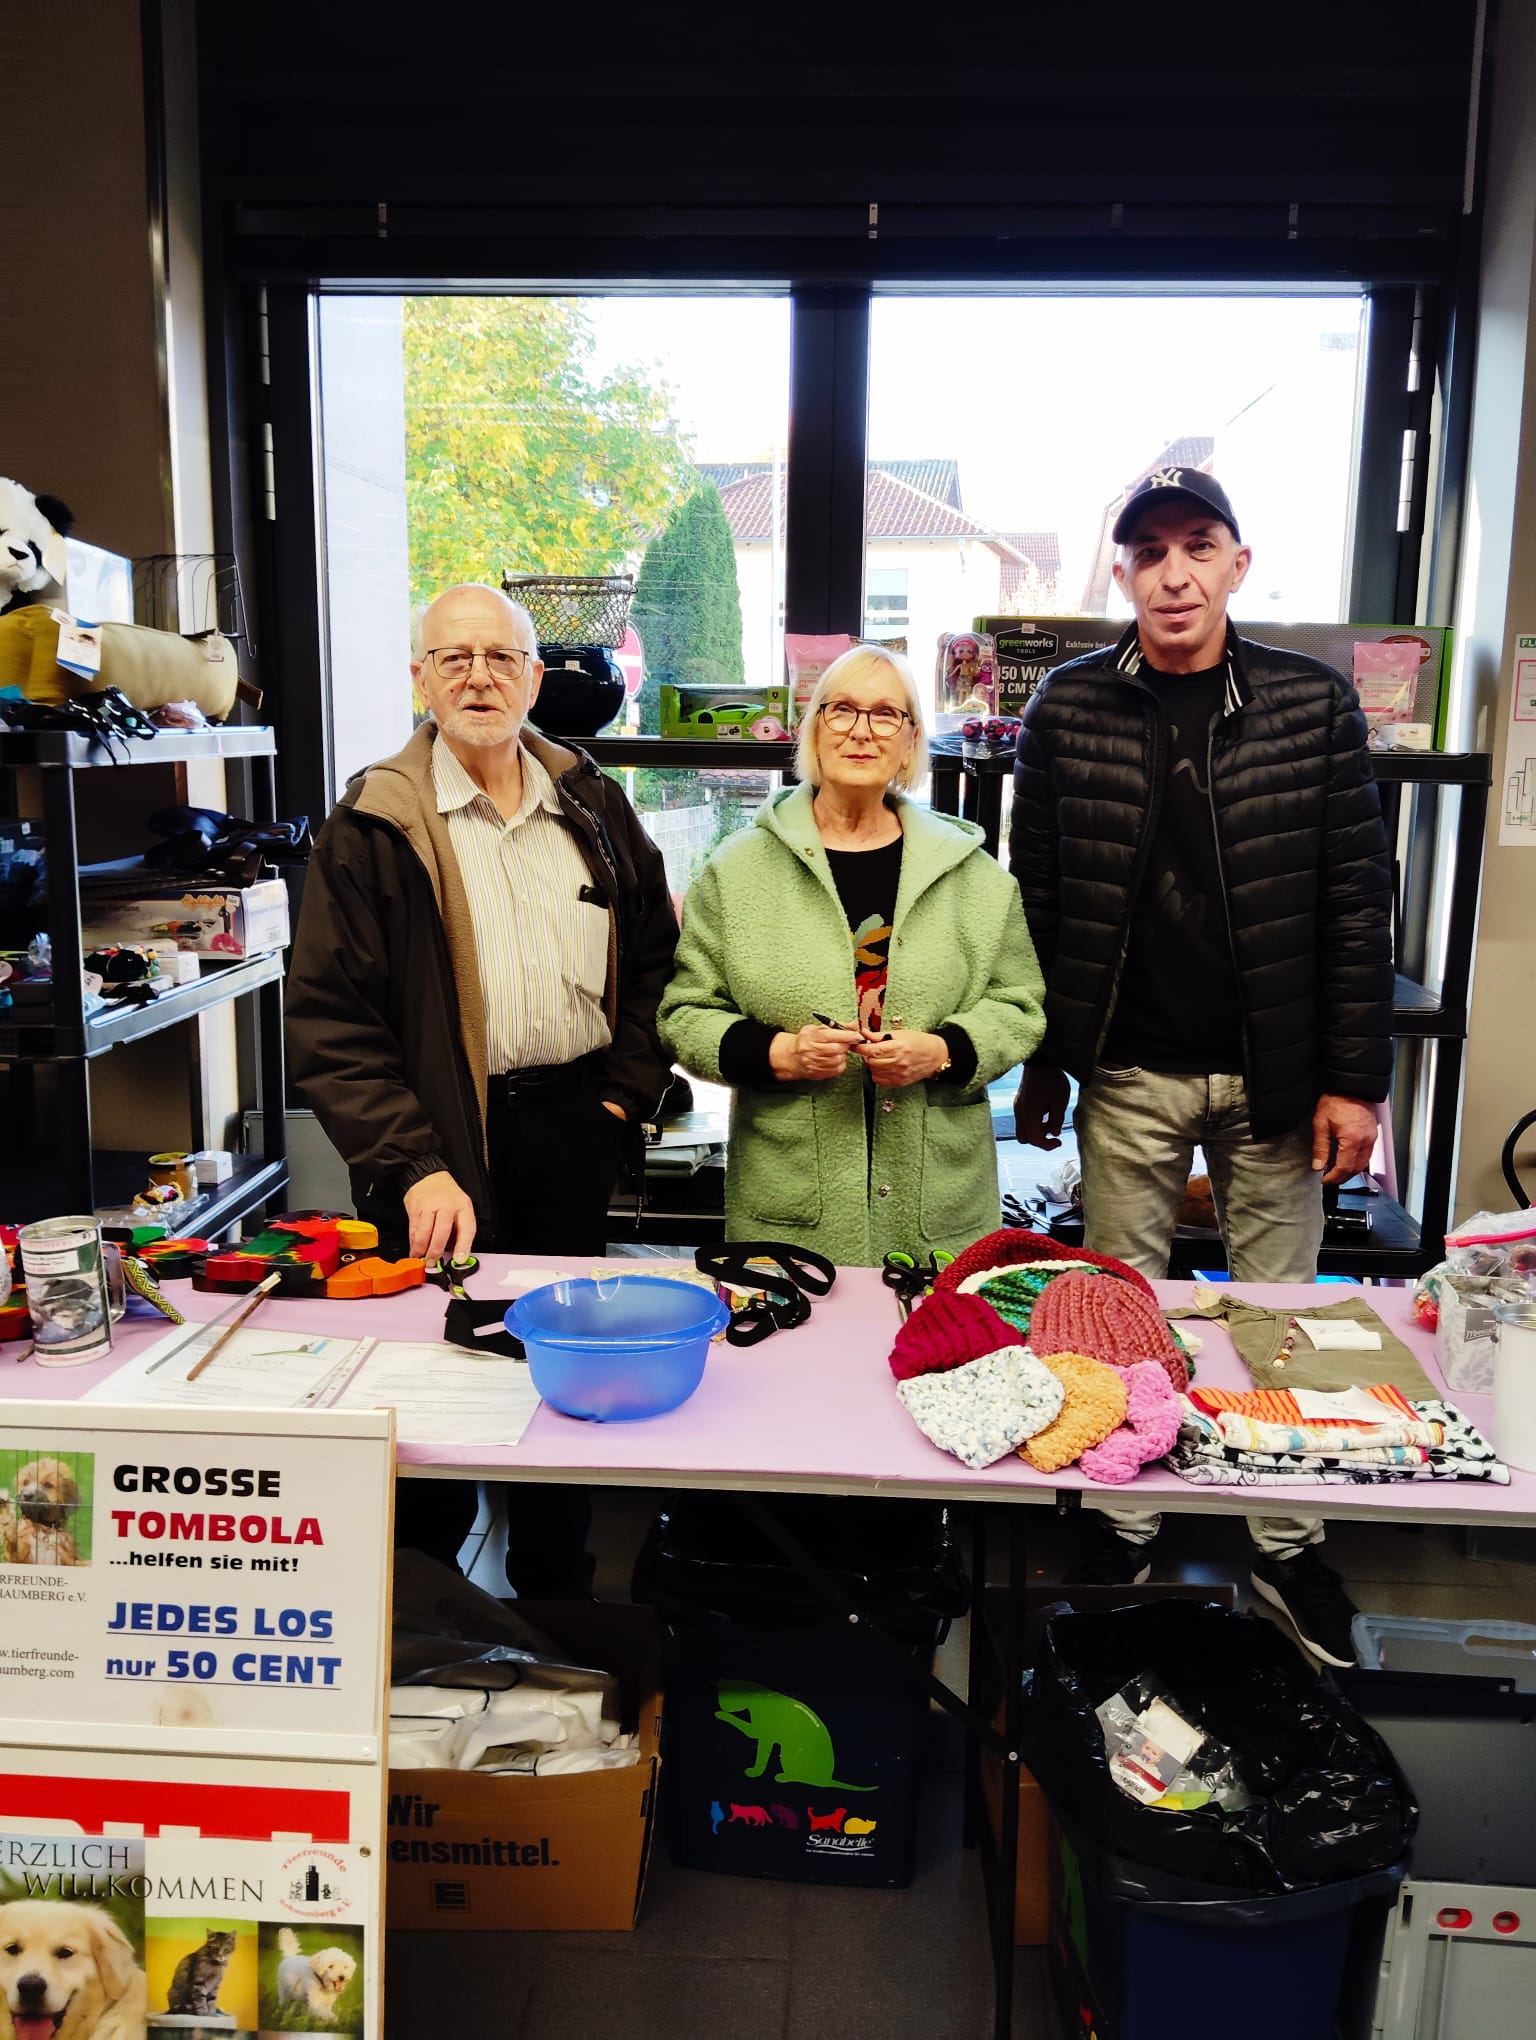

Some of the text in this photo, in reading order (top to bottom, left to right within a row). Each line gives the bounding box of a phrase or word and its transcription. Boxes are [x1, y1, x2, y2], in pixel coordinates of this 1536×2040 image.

[998, 638, 1054, 649] greenworks
[1065, 640, 1107, 649] Exklusiv bei
[1522, 639, 1536, 647] FL
[1007, 682, 1027, 694] CM
[113, 1464, 281, 1498] GROSSE
[111, 1510, 324, 1545] TOMBOLA
[109, 1551, 299, 1572] ...helfen sie mit!
[68, 1592, 87, 1602] e.V.
[107, 1601, 333, 1639] JEDES LOS
[106, 1650, 342, 1685] nur 50 CENT
[806, 1834, 871, 1847] Sanabelle
[22, 1871, 264, 1902] WILLKOMMEN
